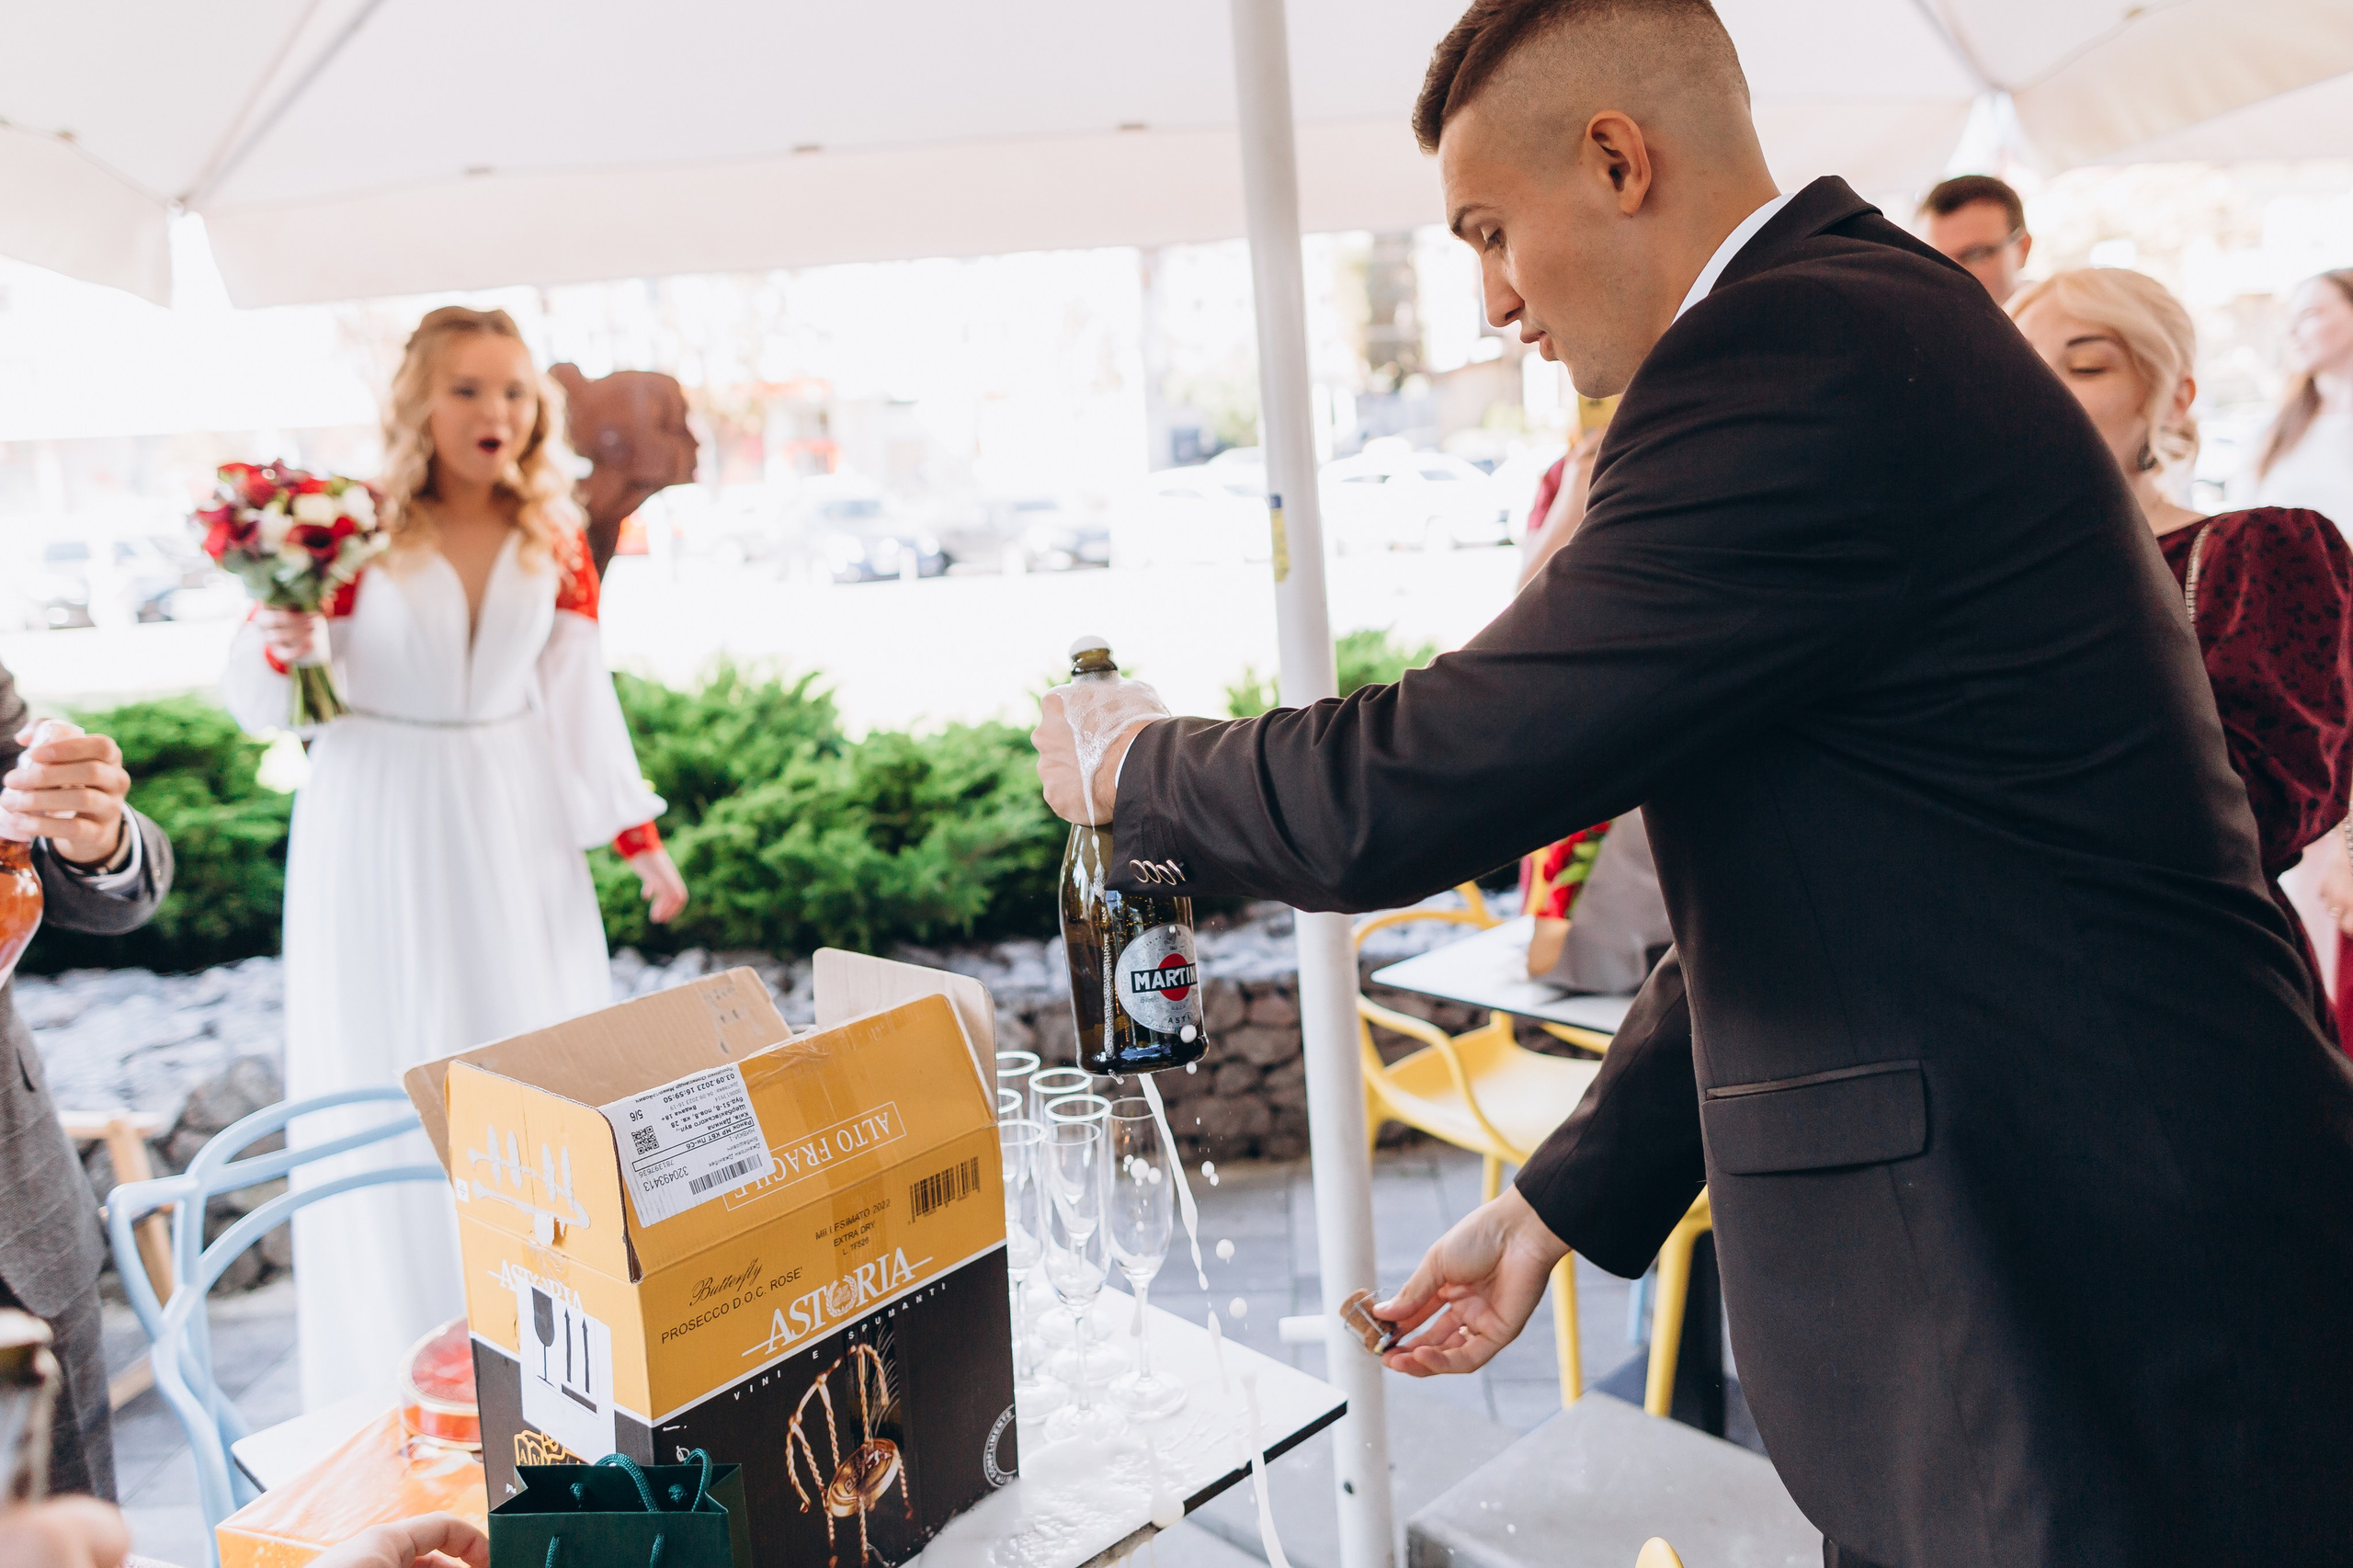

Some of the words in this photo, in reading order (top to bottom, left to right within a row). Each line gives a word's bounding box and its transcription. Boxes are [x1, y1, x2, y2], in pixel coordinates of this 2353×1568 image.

[1168, 1015, 1190, 1023] ASTI
[697, 1073, 735, 1091] 03.09.2023
[663, 1087, 695, 1103] 16:59:50
[630, 1109, 643, 1121] 5/6
[675, 1105, 697, 1116] Видача
[694, 1104, 746, 1127] Щербаківського
[707, 1117, 732, 1131] Данила
[732, 1119, 752, 1131] Ранок
[835, 1111, 891, 1153] ALTO
[686, 1137, 707, 1149] Пн-Сб
[638, 1161, 675, 1177] 781397636
[642, 1165, 688, 1191] 320493413
[872, 1199, 891, 1214] 2022
[833, 1230, 859, 1247] EXTRA
[860, 1221, 876, 1234] DRY
[688, 1257, 763, 1307] Butterfly
[764, 1246, 916, 1356] ASTORIA
[661, 1302, 730, 1344] PROSECCO
[733, 1285, 767, 1310] D.O.C.
[733, 1369, 781, 1402] VINI
[812, 1349, 820, 1360] E
[847, 1282, 947, 1340] SPUMANTI
